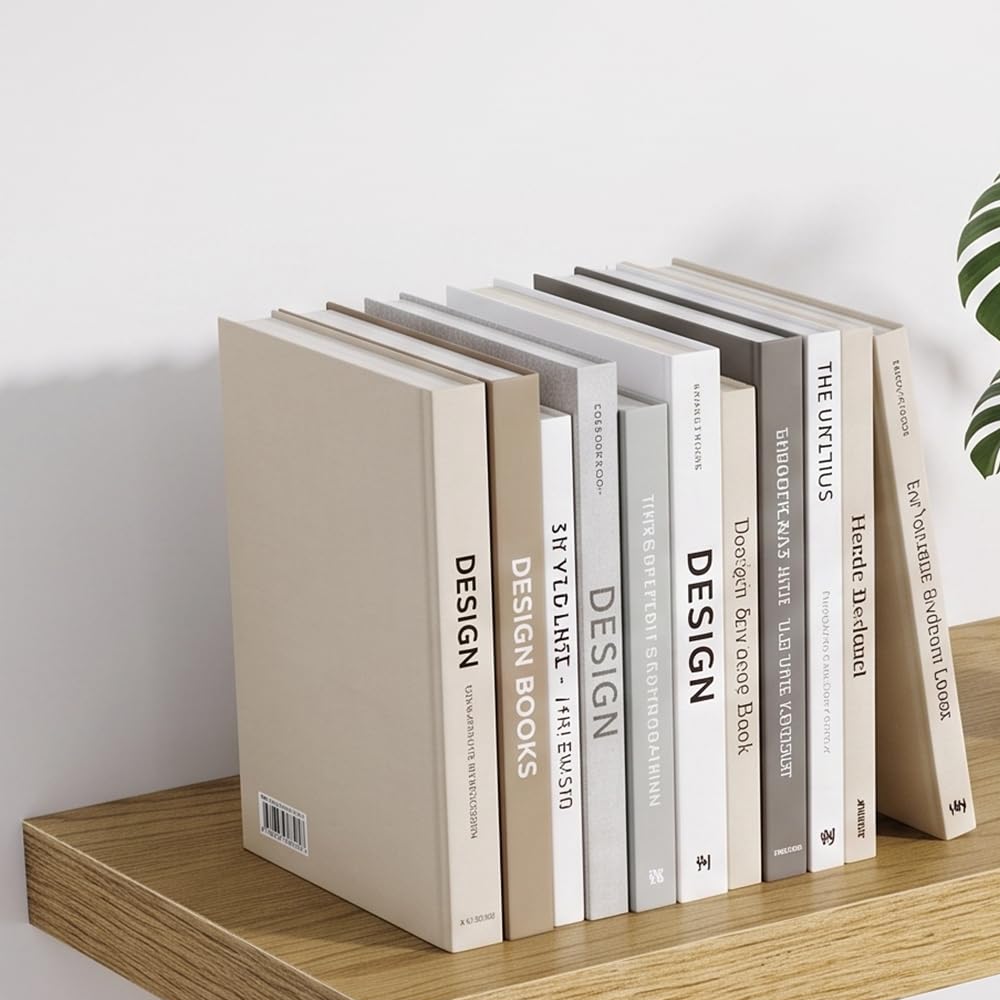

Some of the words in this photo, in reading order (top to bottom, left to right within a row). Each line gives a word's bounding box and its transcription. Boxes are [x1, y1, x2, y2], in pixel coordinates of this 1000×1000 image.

[817, 360, 833, 403] THE
[455, 554, 479, 670] DESIGN
[511, 556, 535, 667] DESIGN
[589, 585, 619, 739] DESIGN
[686, 548, 715, 705] DESIGN
[515, 675, 538, 779] BOOKS
